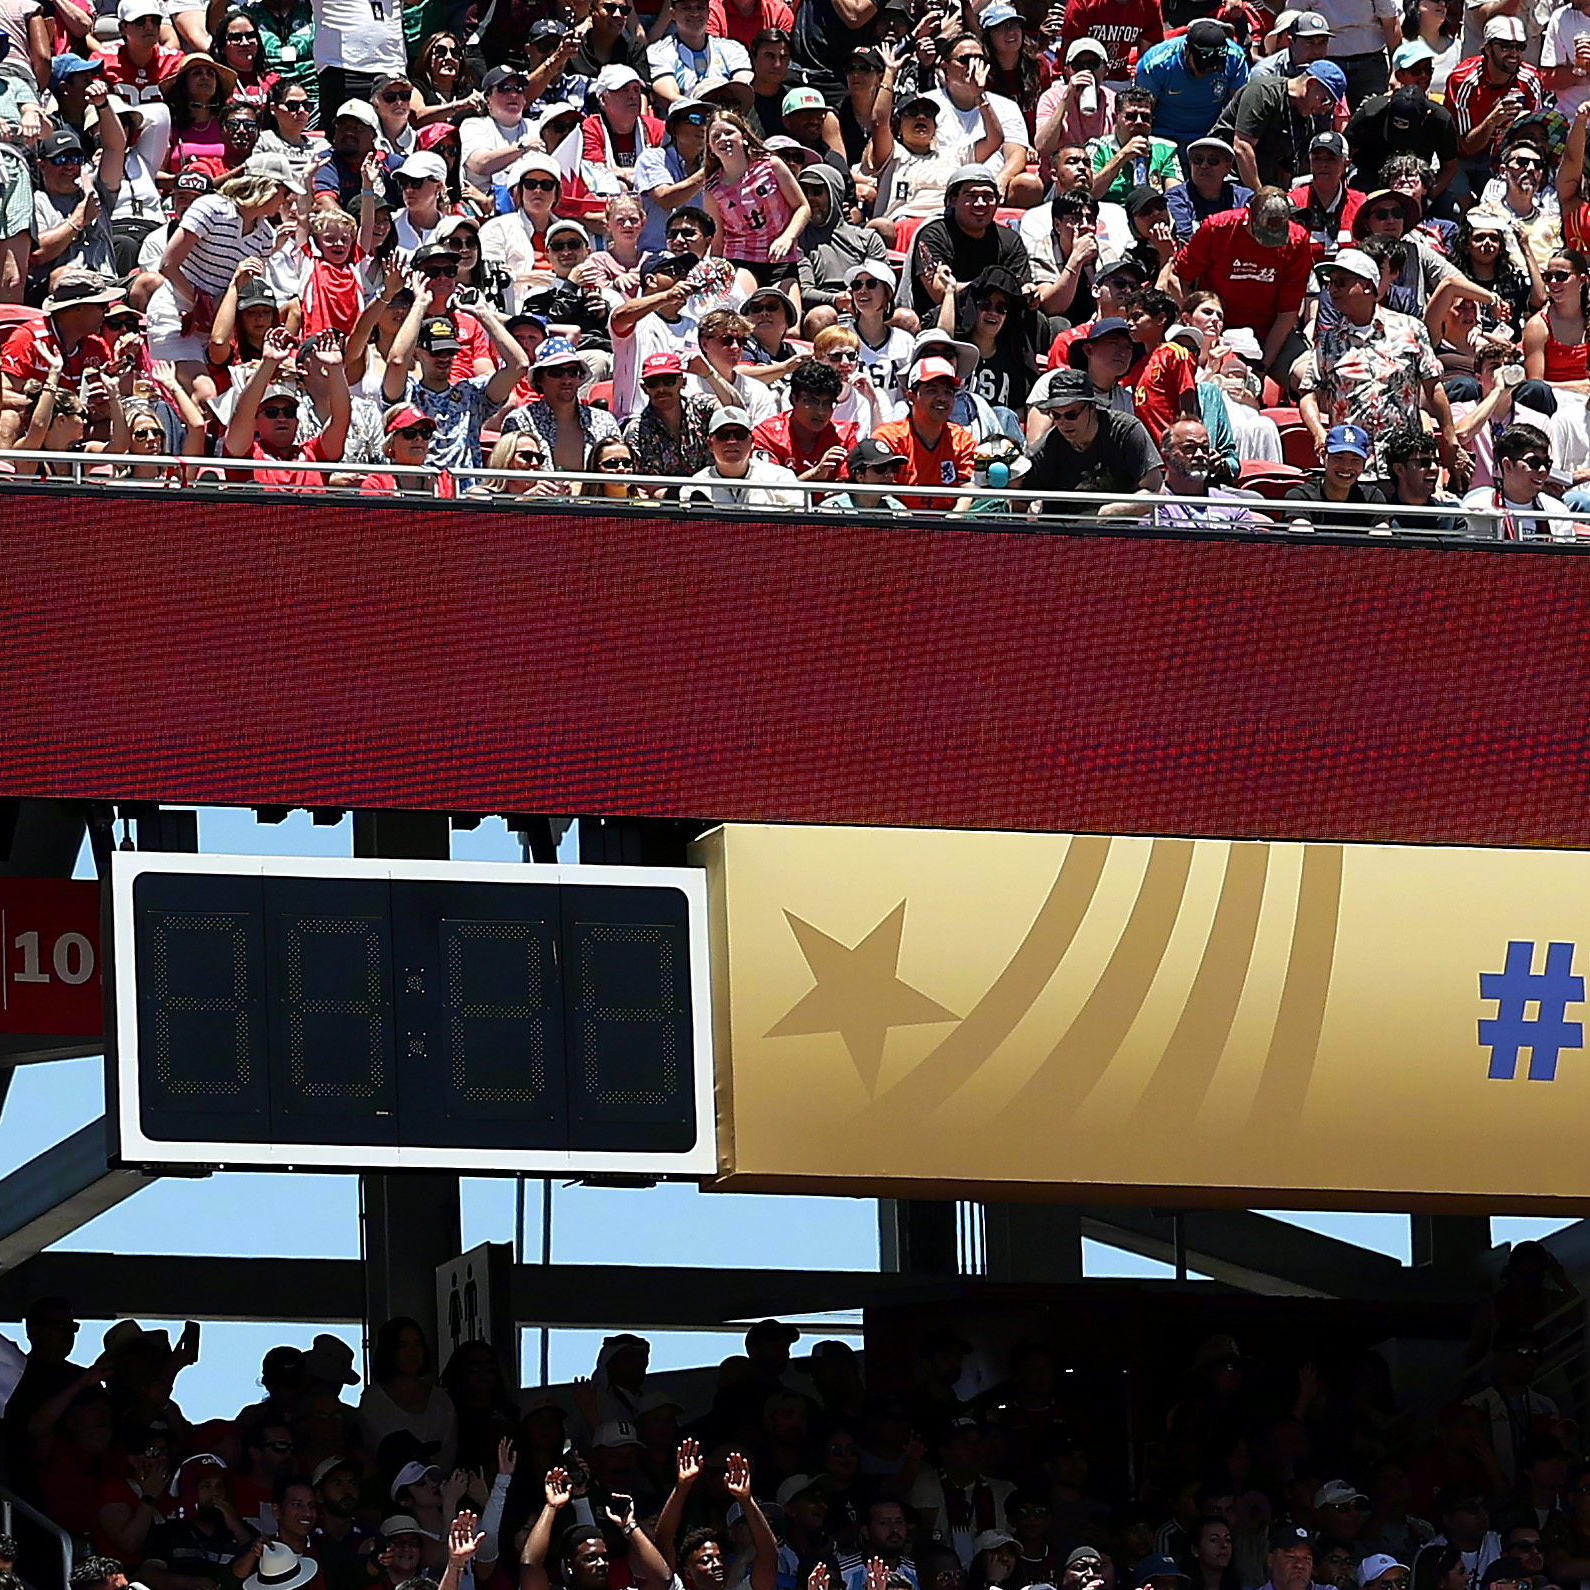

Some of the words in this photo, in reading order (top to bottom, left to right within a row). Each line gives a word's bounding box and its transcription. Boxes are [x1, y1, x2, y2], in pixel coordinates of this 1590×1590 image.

[1087, 24, 1145, 43] TANFOR
[1344, 428, 1356, 443] LA
[13, 931, 95, 985] 10
